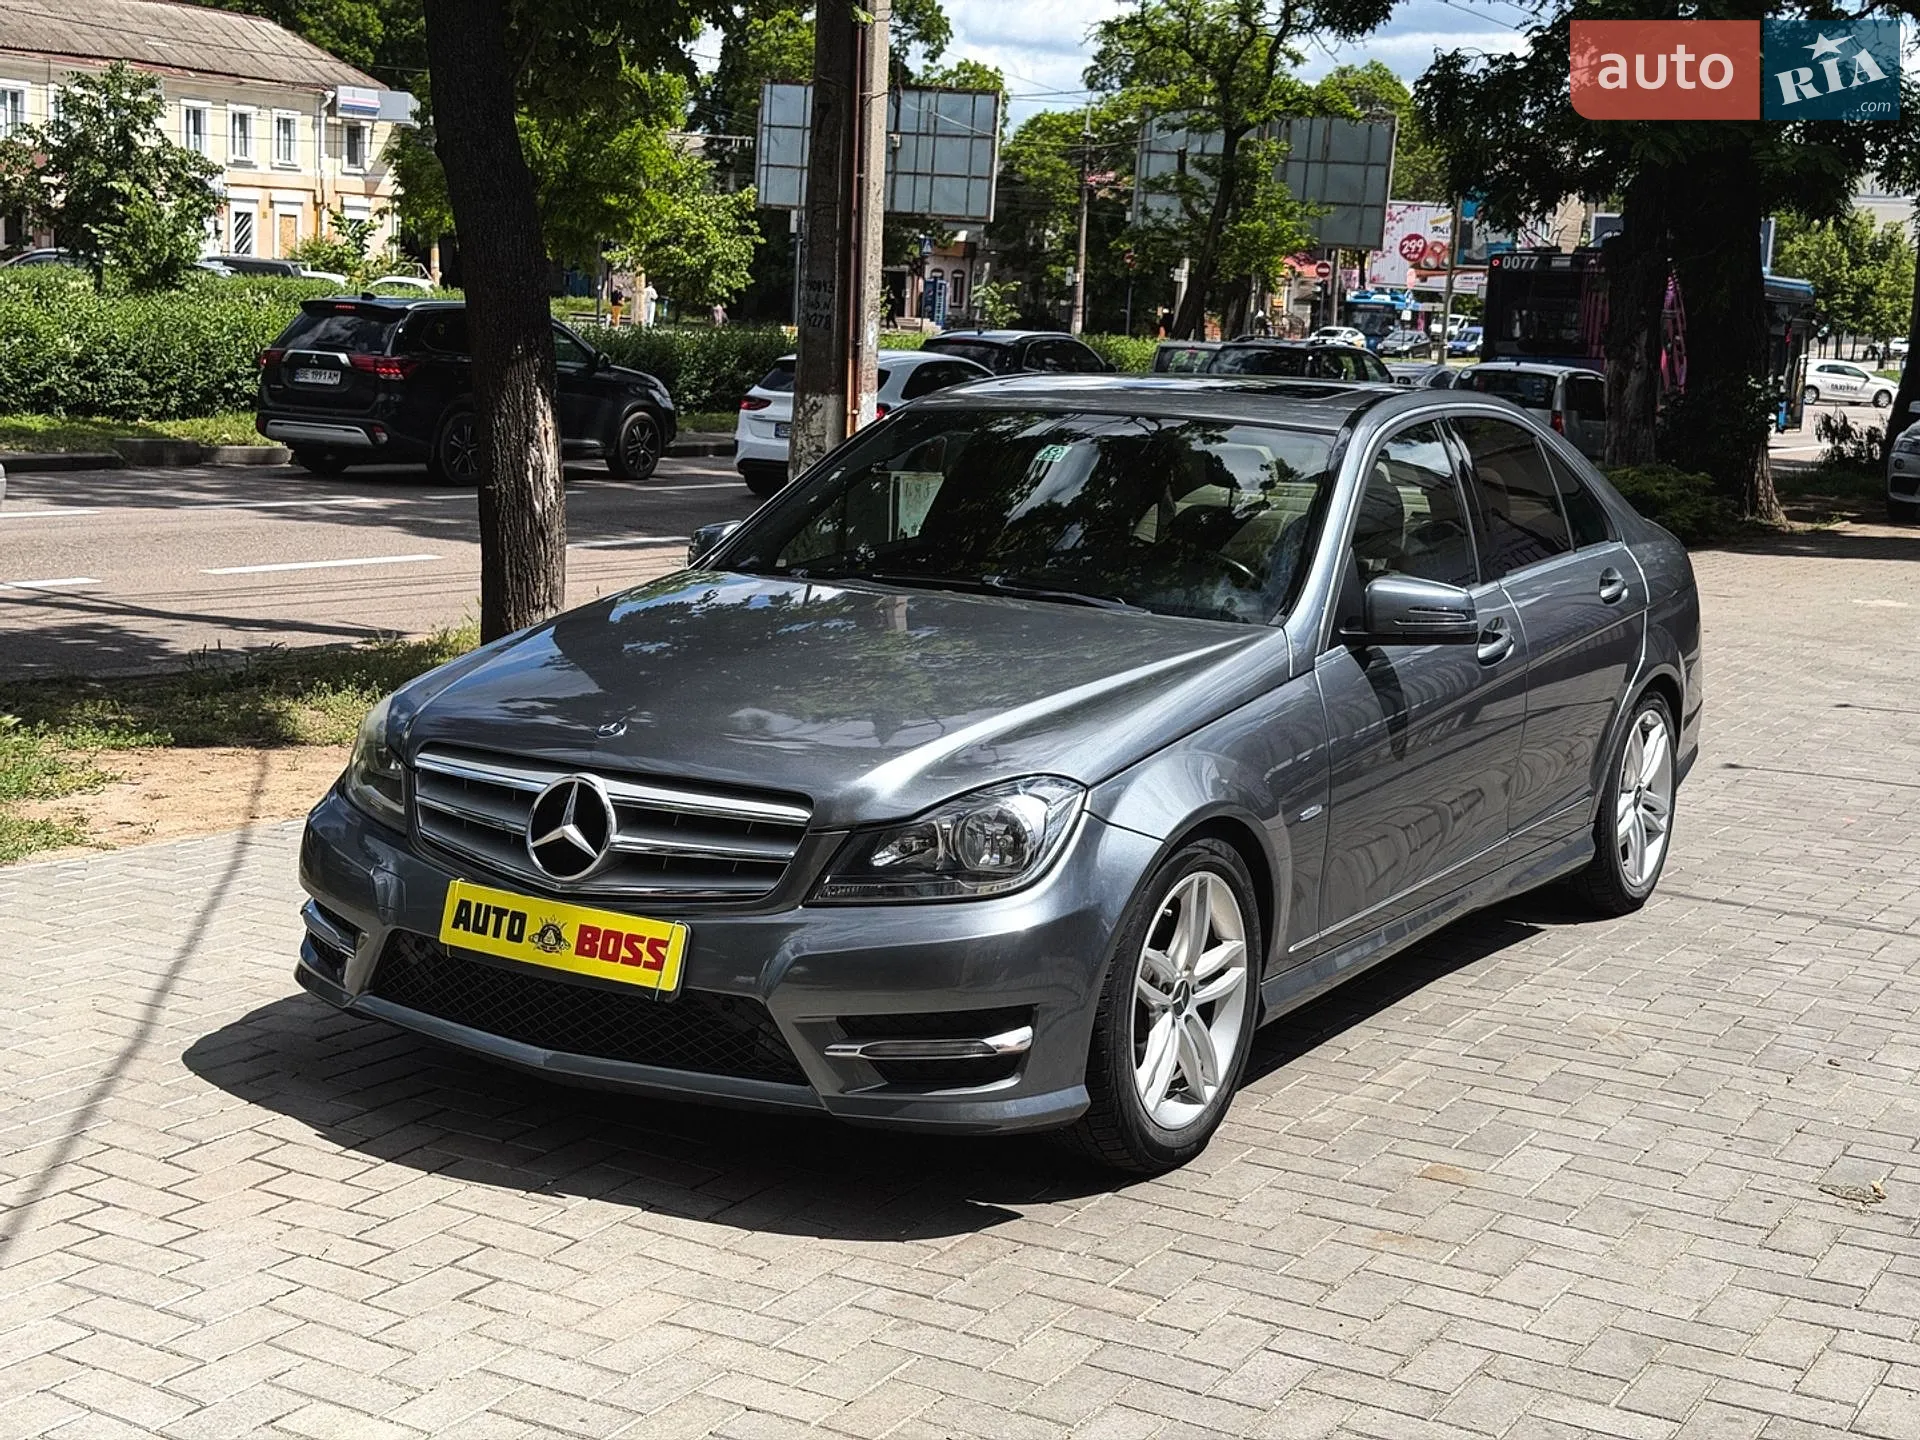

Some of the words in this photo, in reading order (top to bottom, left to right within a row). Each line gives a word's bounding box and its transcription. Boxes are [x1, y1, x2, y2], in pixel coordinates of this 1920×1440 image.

[1401, 239, 1424, 254] 299
[1502, 256, 1539, 270] 0077
[451, 899, 528, 944] AUTO
[574, 923, 670, 972] BOSS
